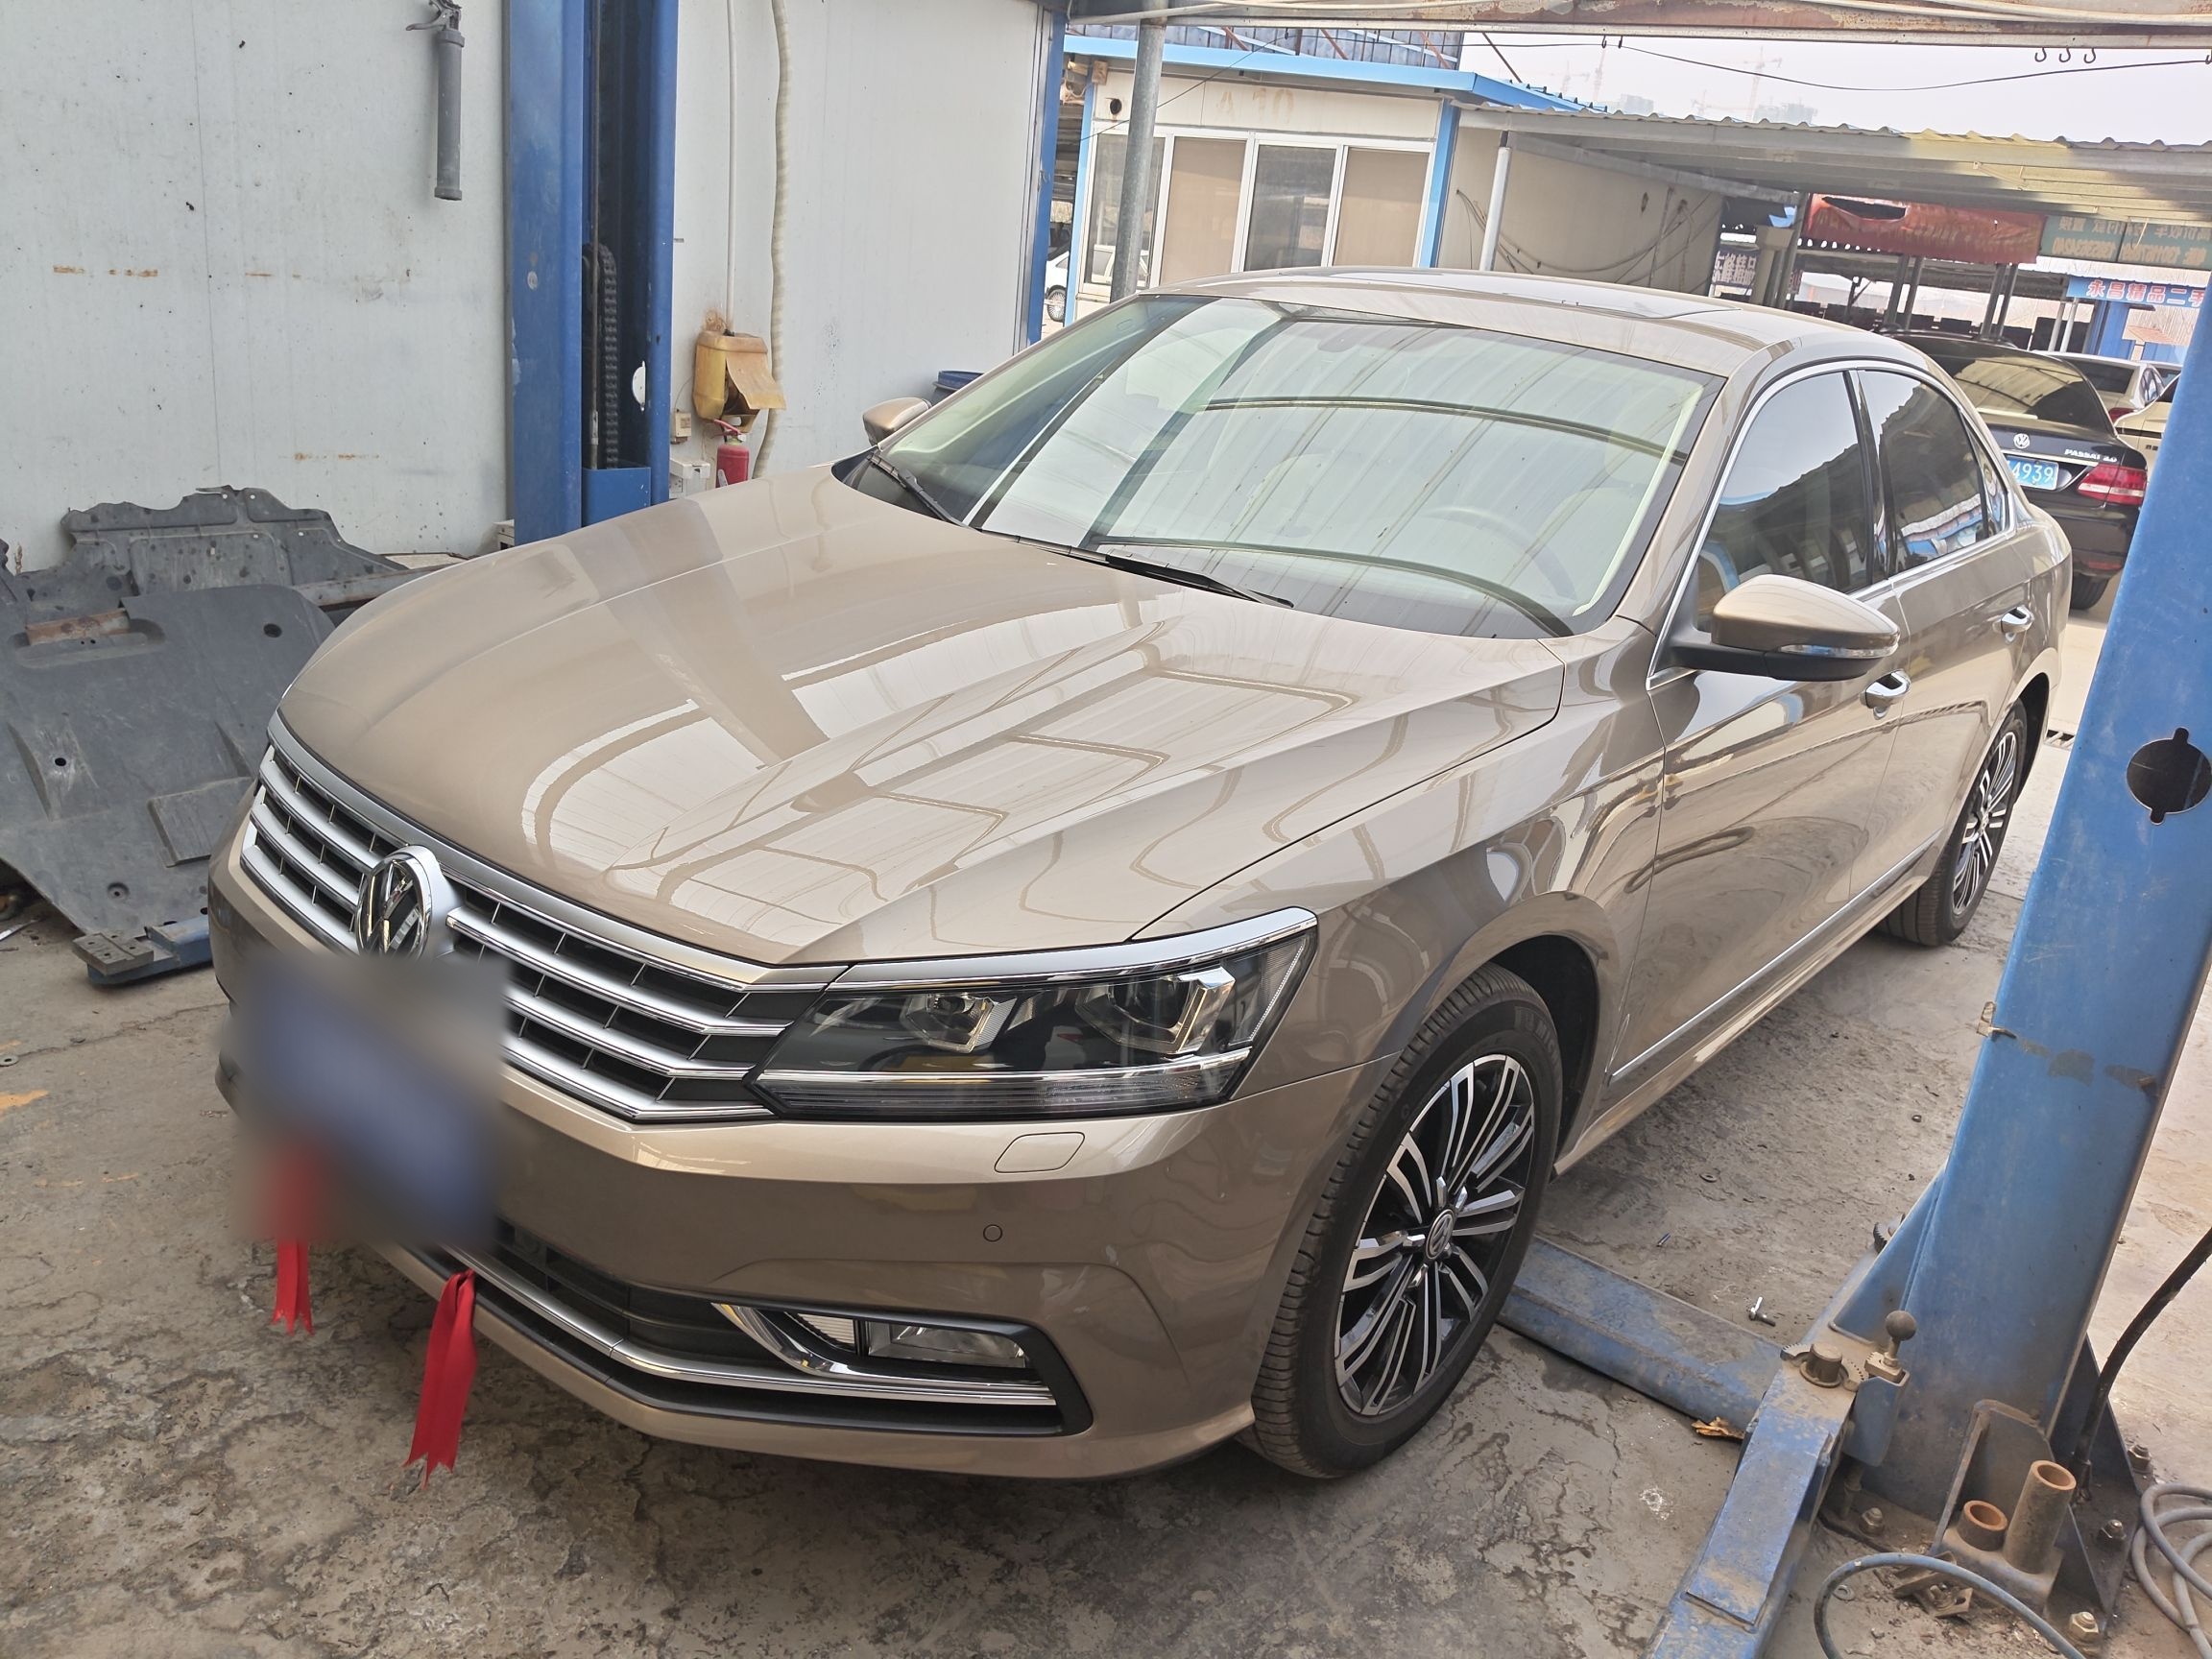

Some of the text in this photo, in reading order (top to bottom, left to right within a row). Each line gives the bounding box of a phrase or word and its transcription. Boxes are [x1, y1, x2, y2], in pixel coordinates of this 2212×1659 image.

[2086, 278, 2205, 307] 永昌精品二手
[2064, 448, 2101, 460] PASSAT
[2008, 460, 2055, 484] 4939
